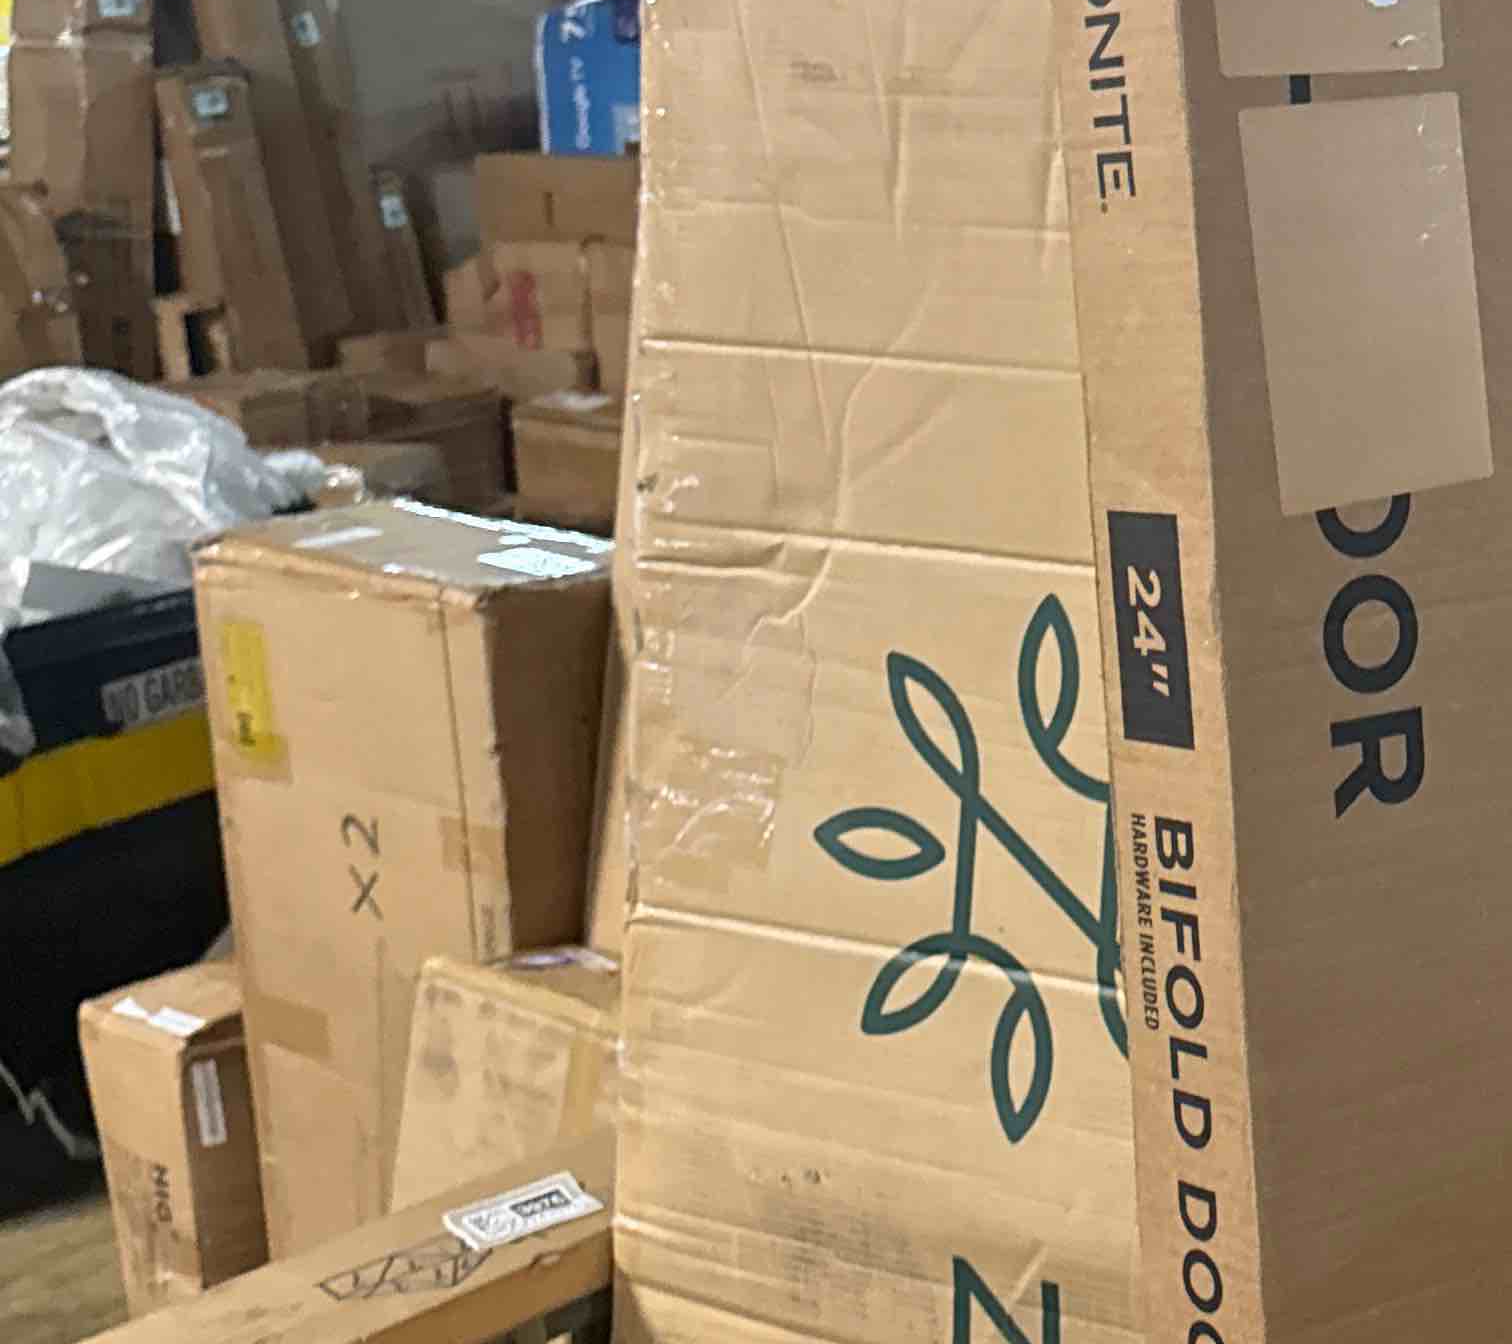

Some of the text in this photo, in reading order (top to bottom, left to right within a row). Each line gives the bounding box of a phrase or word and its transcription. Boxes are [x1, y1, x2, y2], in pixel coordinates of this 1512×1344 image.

[1124, 566, 1170, 698] 24"
[1129, 812, 1159, 1031] HARDWARE INCLUDED
[1153, 815, 1213, 1149] BIFOLD
